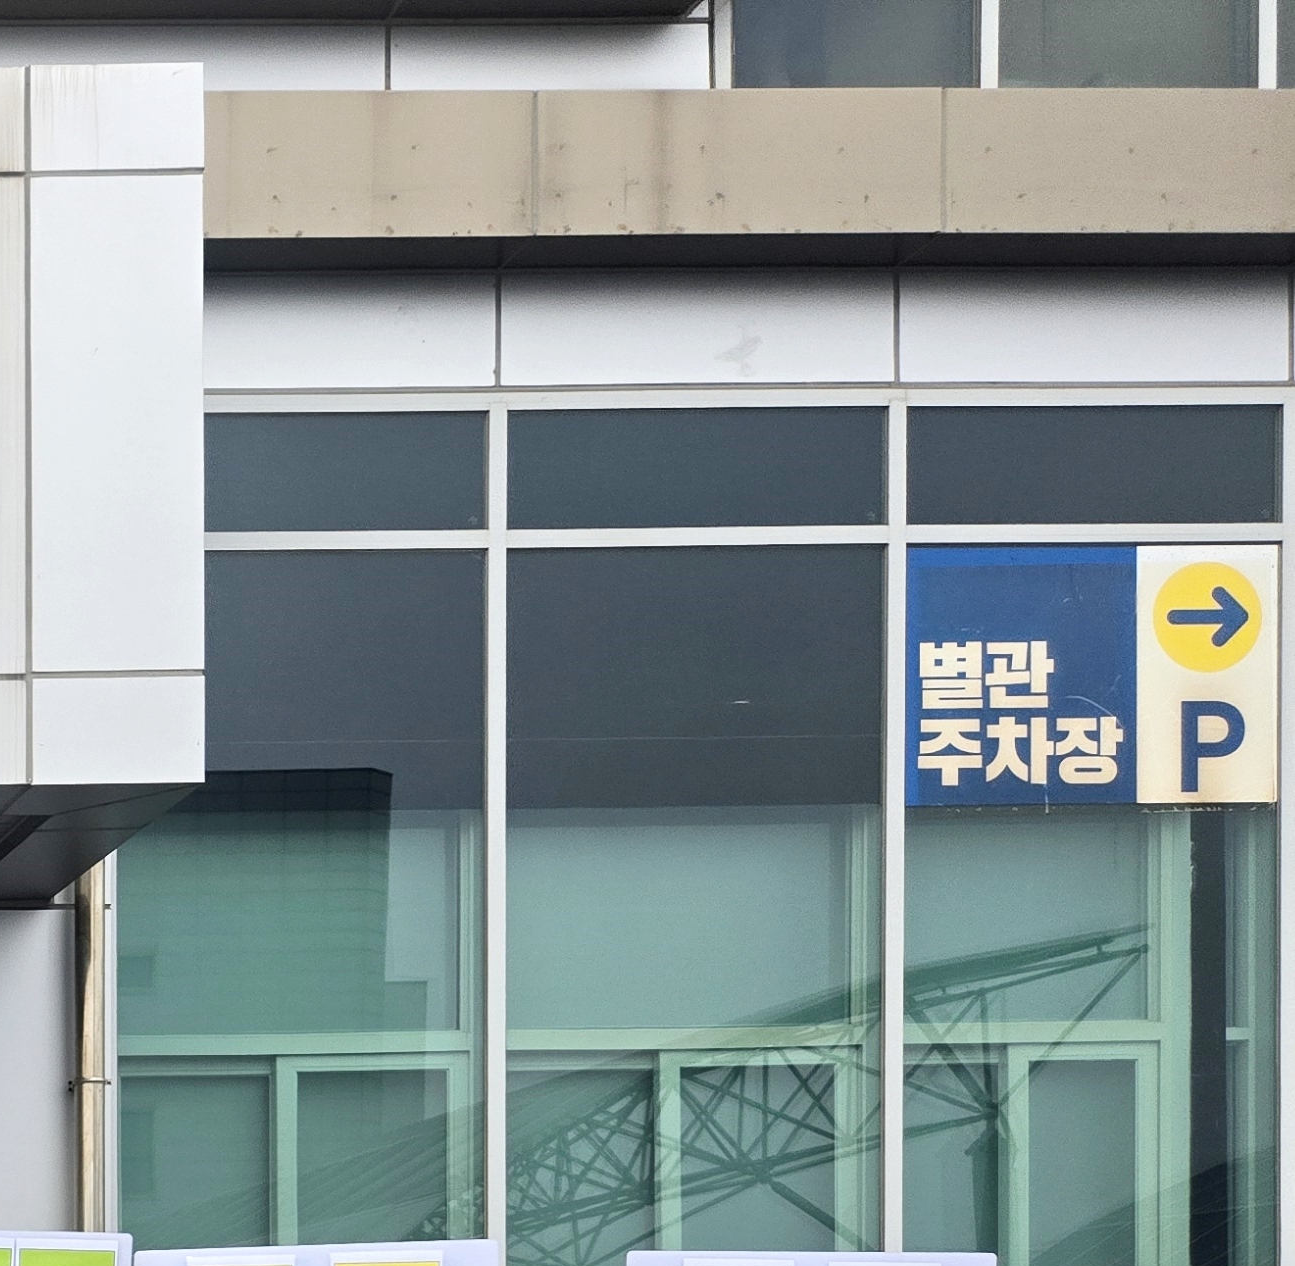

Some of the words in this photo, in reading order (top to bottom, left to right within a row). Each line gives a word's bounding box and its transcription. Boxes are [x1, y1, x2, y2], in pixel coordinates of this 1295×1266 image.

[918, 640, 1055, 709] 별관
[917, 716, 1124, 786] 주차장
[1180, 700, 1246, 793] P
